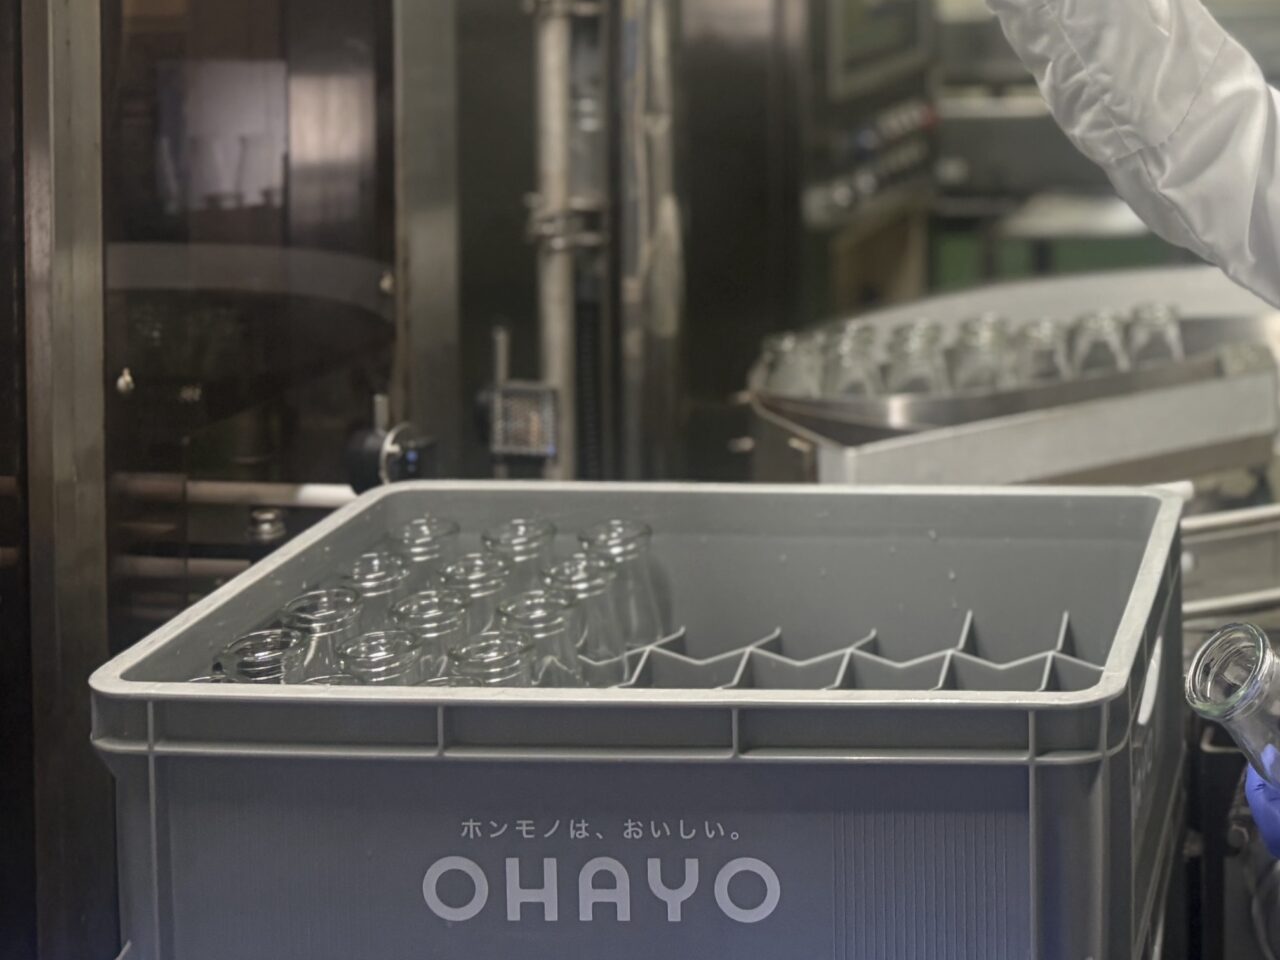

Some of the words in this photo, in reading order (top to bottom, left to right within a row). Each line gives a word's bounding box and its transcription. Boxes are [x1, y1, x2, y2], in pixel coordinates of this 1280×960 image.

[461, 819, 740, 840] ホンモノは、おいしい。
[422, 856, 781, 923] OHAYO
